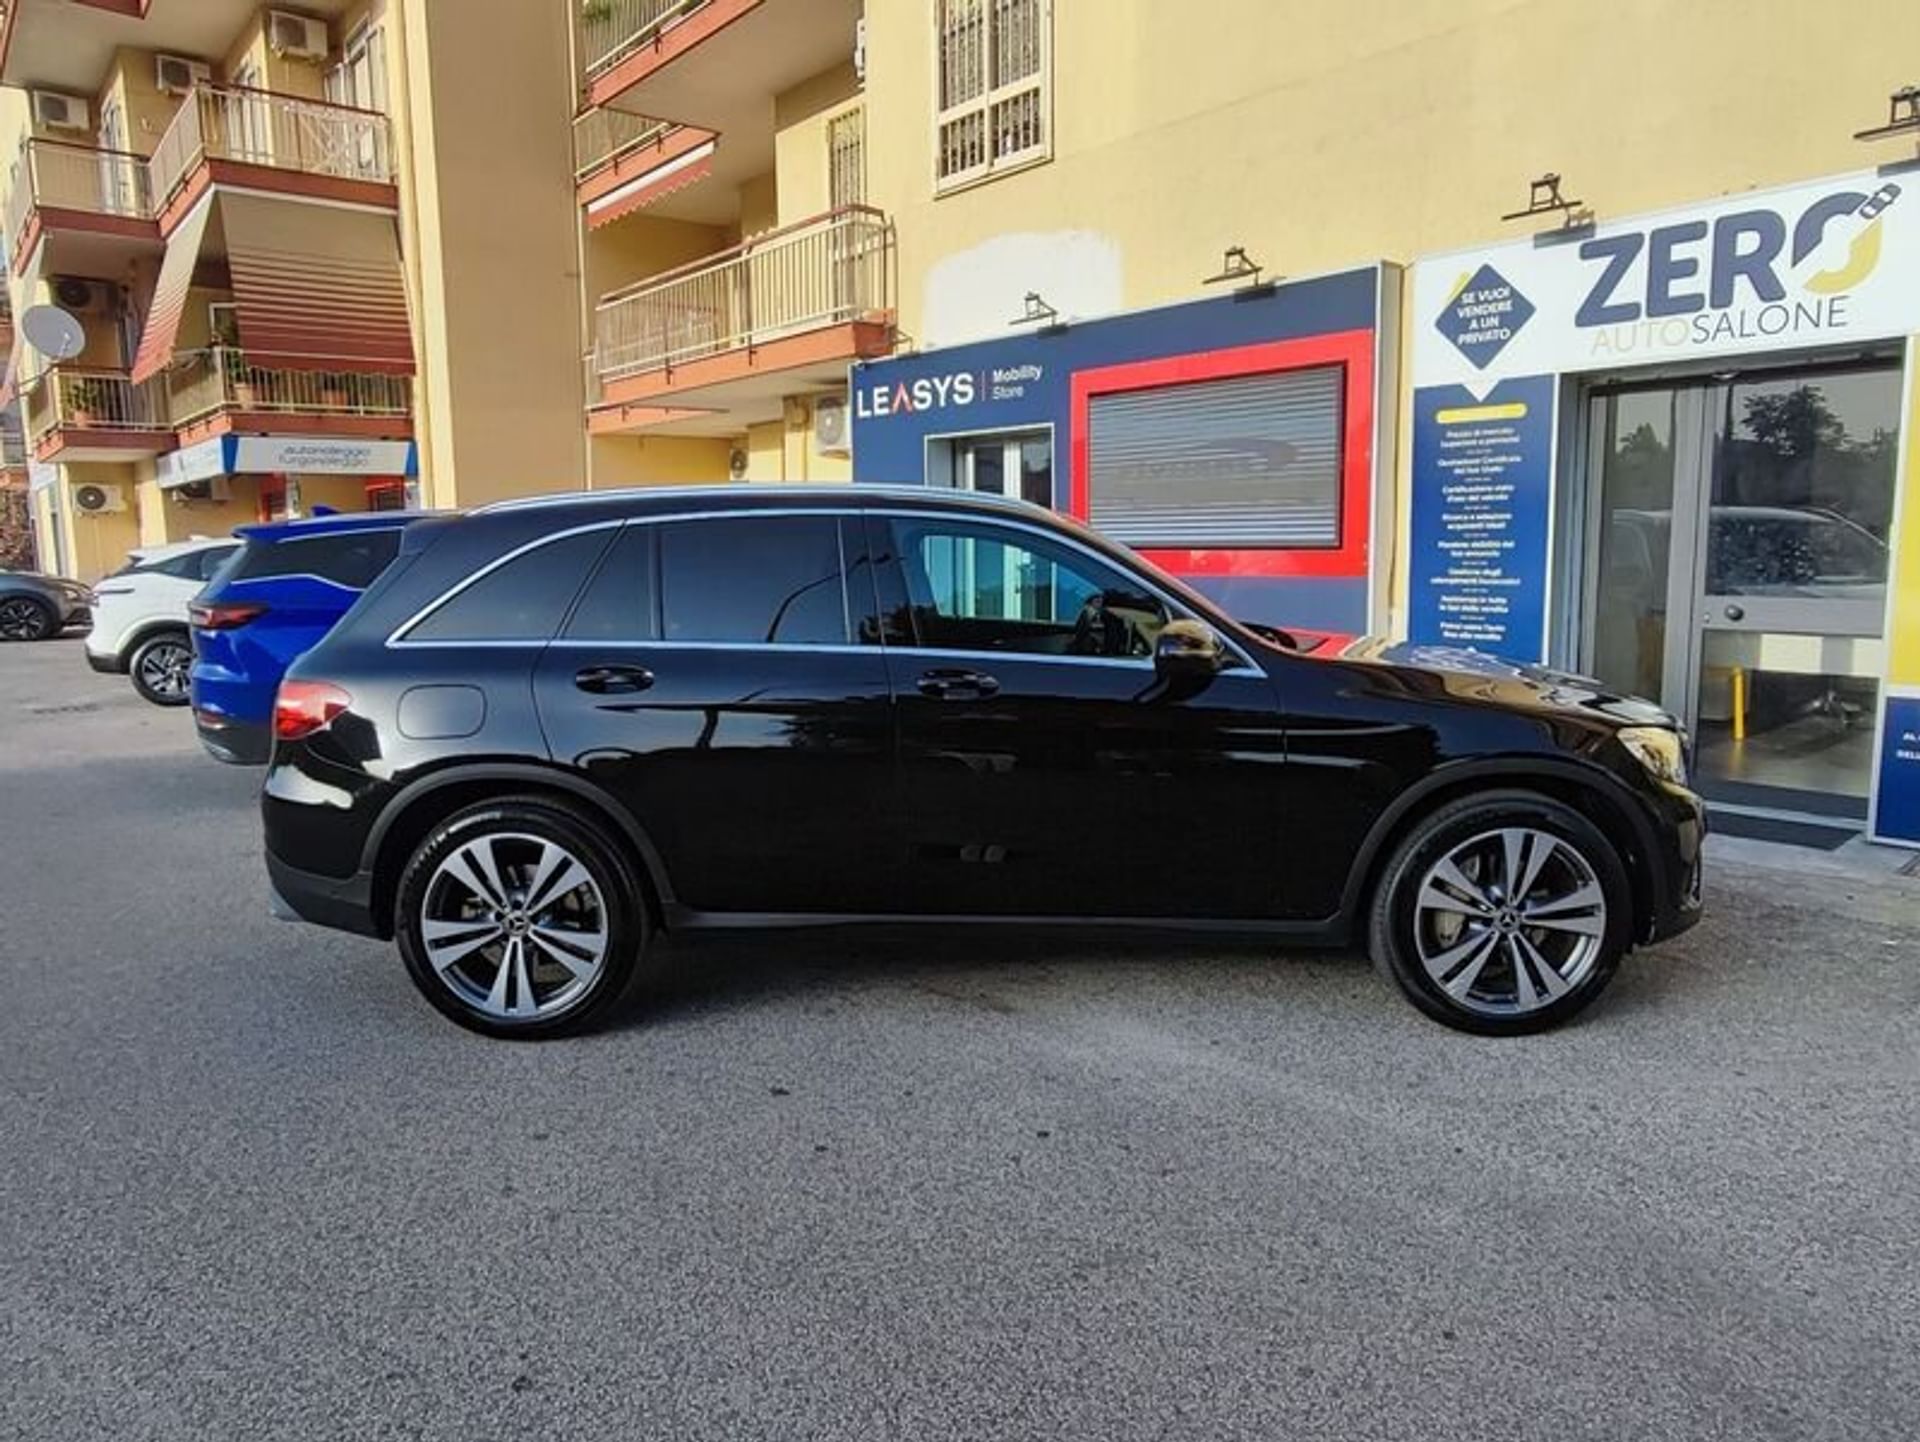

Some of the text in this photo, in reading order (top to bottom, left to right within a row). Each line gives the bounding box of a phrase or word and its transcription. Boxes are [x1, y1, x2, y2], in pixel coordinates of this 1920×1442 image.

[1574, 191, 1883, 328] ZERO
[1461, 291, 1476, 304] SE
[1456, 300, 1514, 319] VENDERE
[1468, 314, 1501, 331] A UN
[1457, 327, 1512, 346] PRIVATO
[992, 364, 1044, 384] Mobility
[857, 372, 975, 419] LEASYS
[992, 384, 1026, 401] Store
